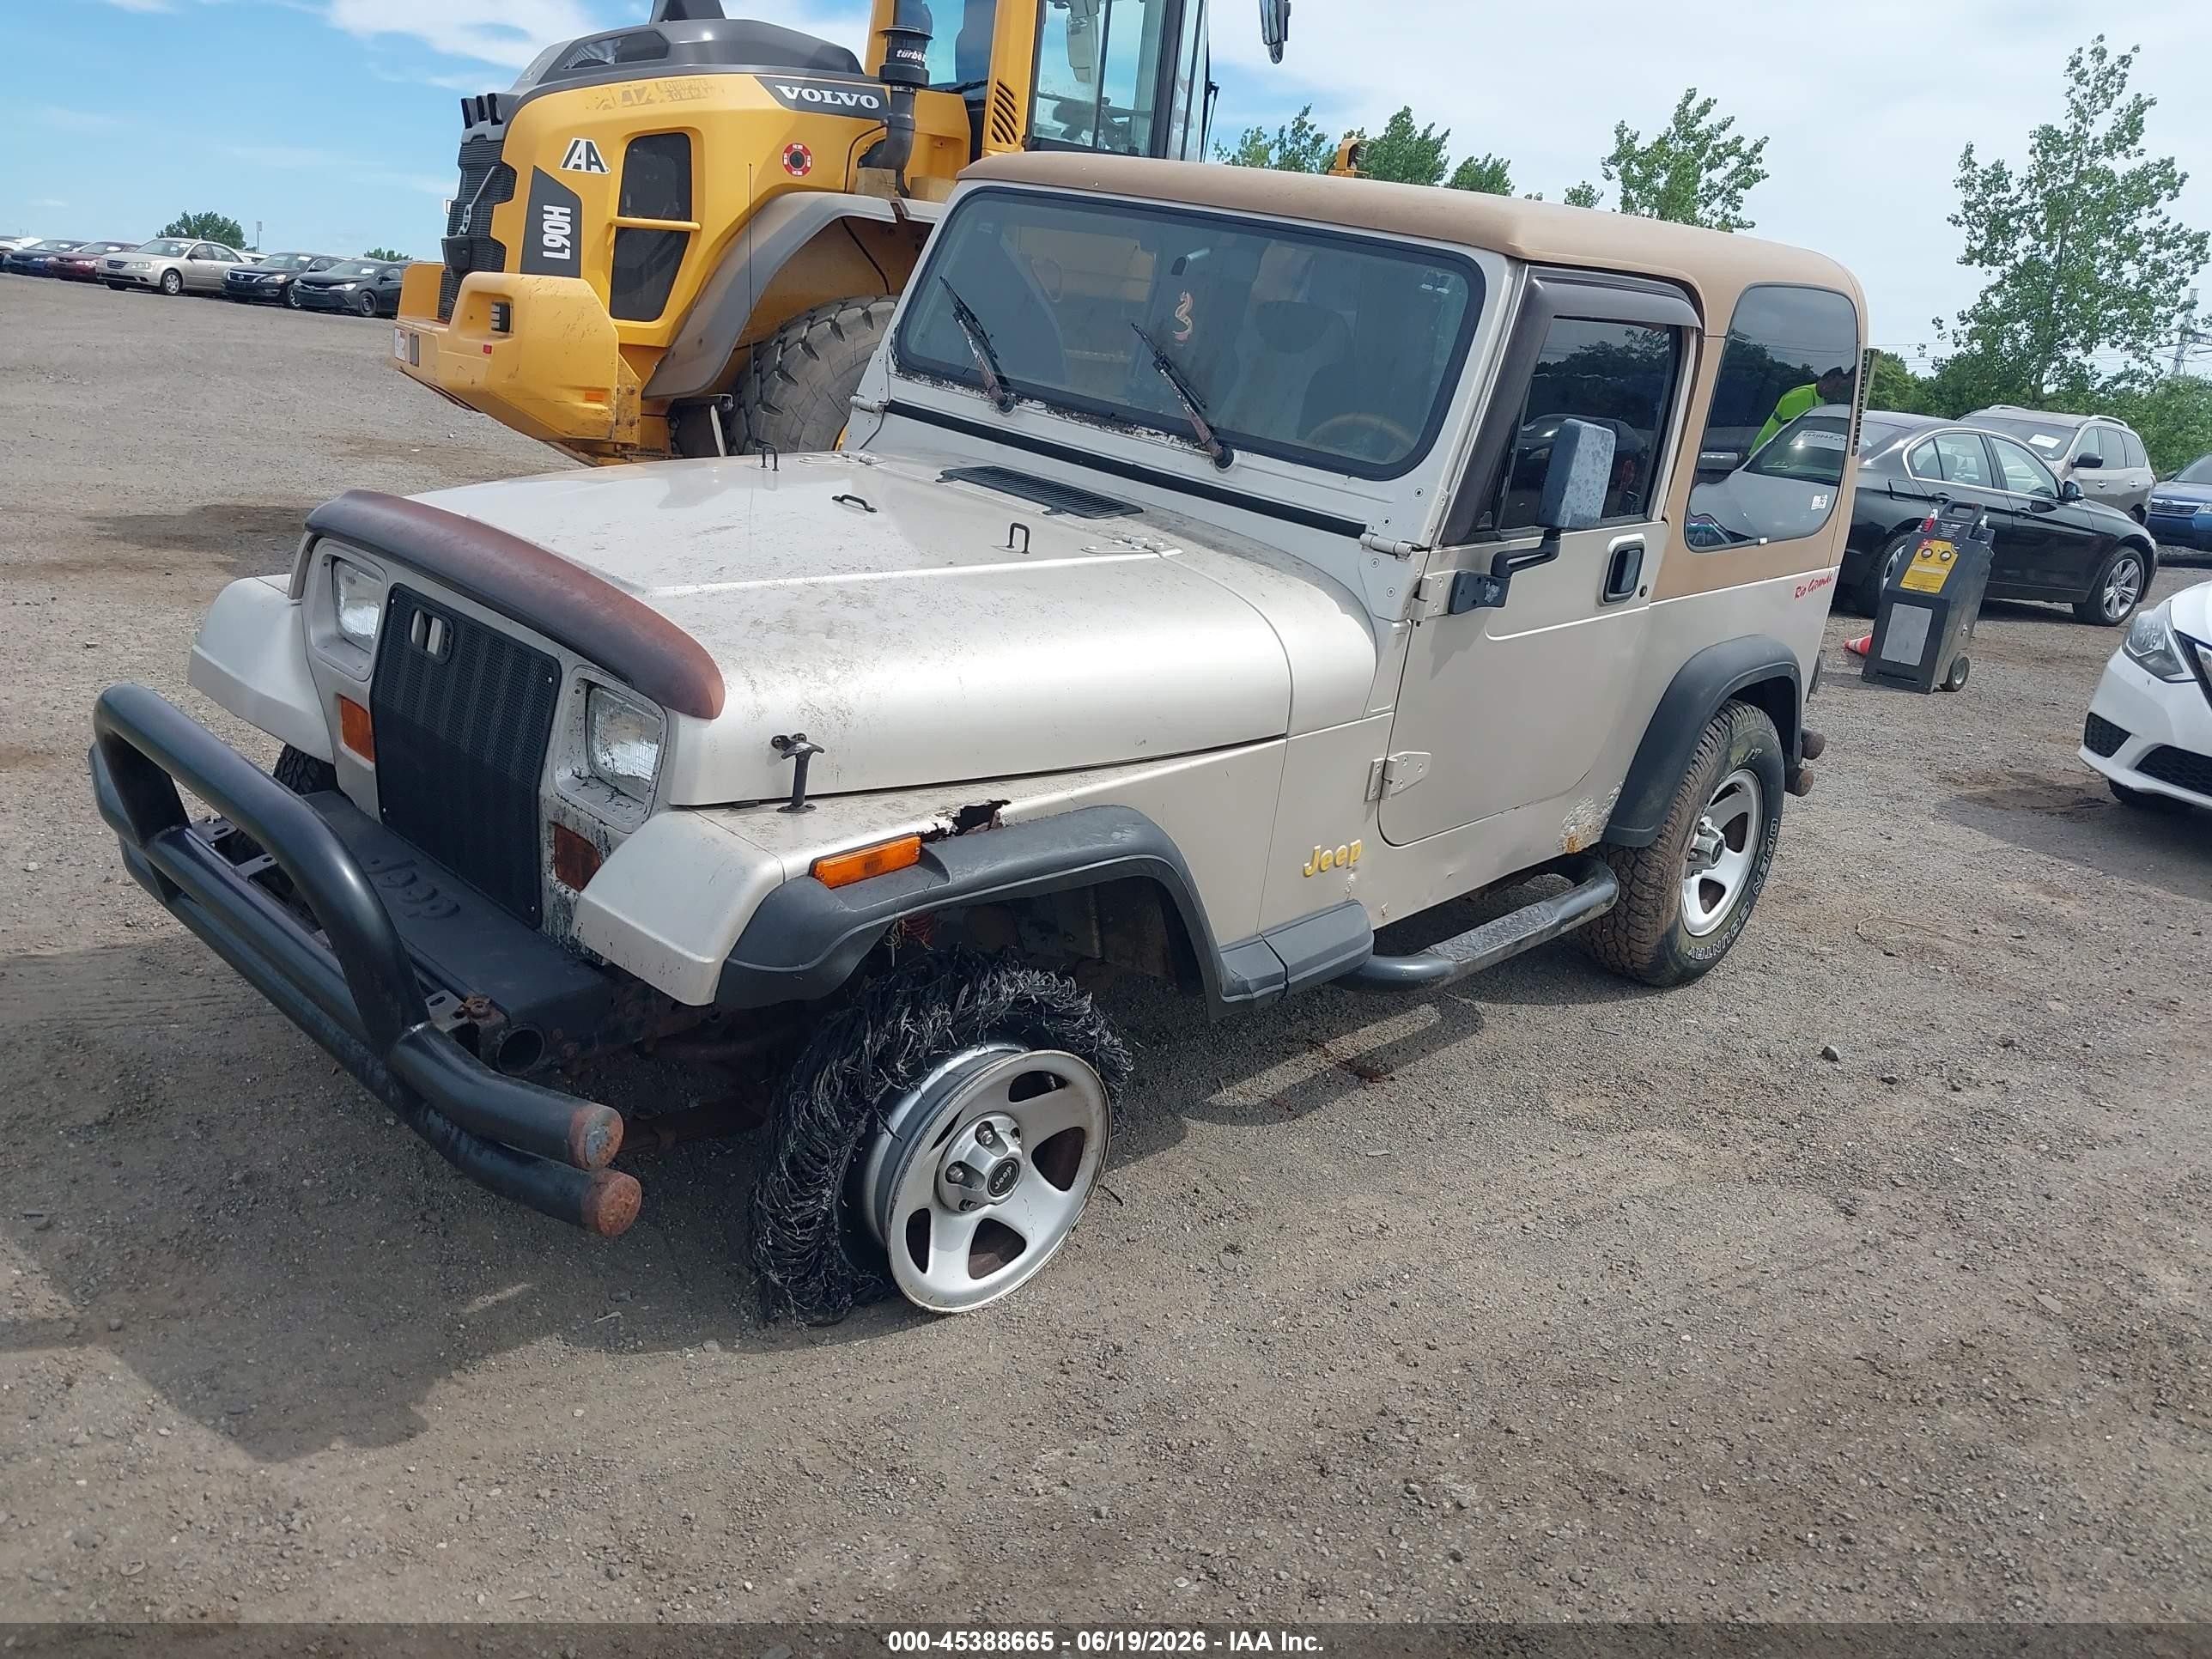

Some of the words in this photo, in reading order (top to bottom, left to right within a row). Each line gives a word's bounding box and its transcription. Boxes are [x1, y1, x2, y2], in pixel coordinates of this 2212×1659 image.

[775, 85, 880, 109] VOLVO
[542, 204, 572, 260] L90H
[1794, 585, 1807, 600] Rio
[1304, 839, 1362, 878] Jeep
[1753, 817, 1778, 895] OPEN
[1687, 902, 1750, 960] COUNTRY
[994, 1165, 1013, 1190] Jeep
